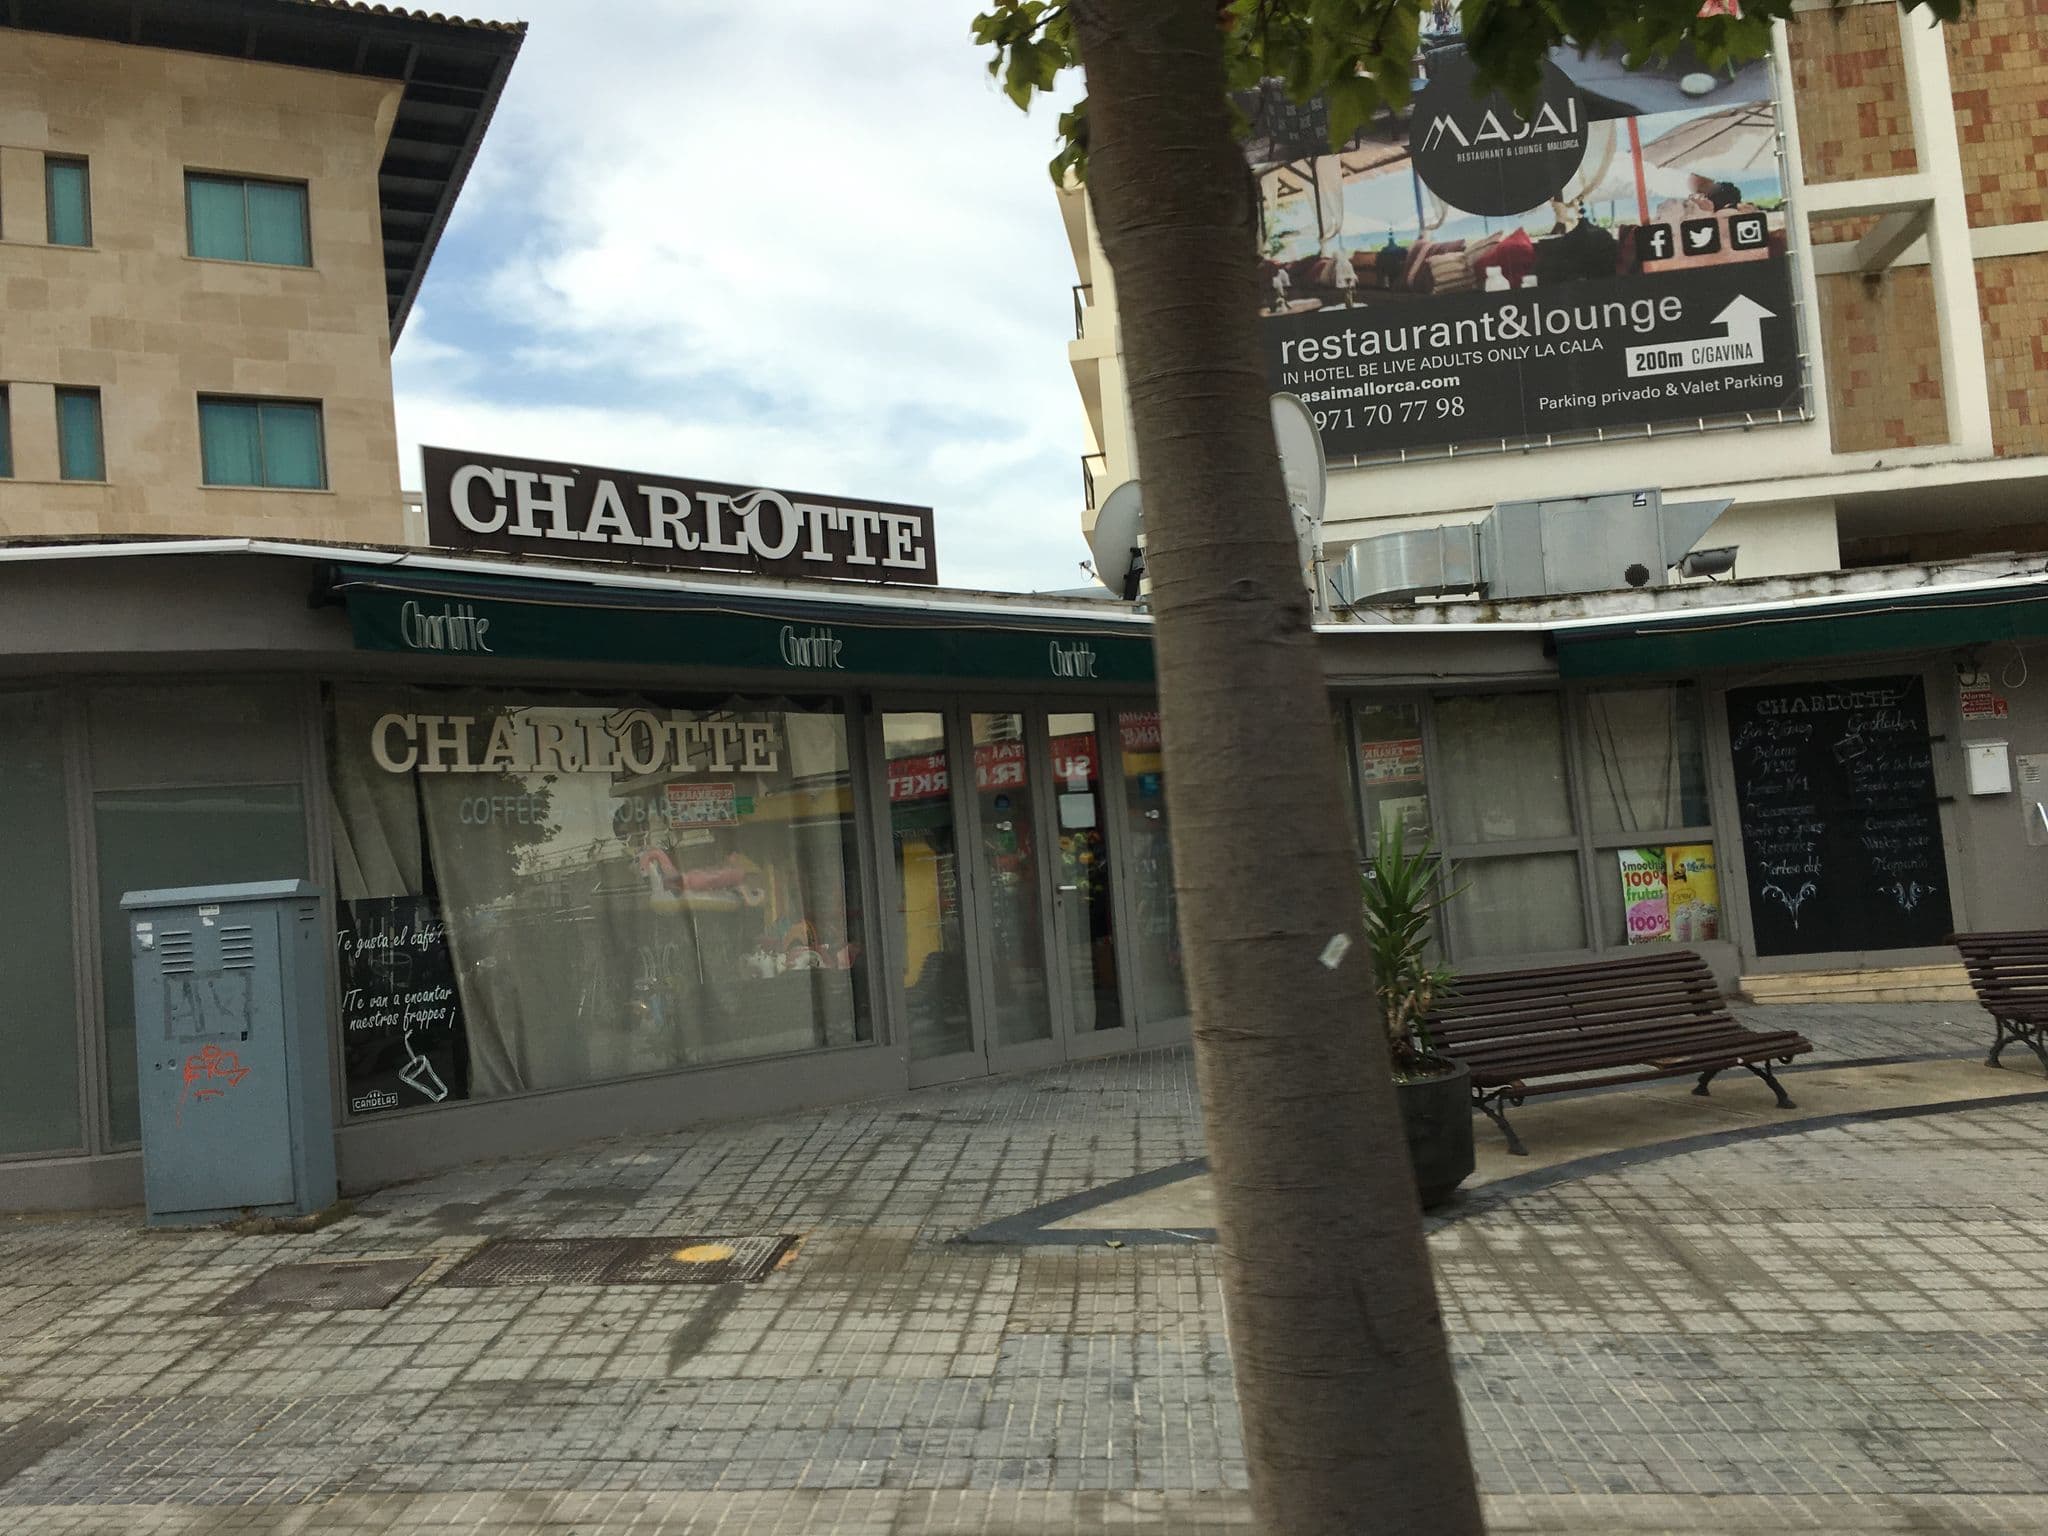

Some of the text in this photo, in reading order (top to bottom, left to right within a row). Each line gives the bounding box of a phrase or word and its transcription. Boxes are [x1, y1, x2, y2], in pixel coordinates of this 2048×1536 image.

[1457, 149, 1504, 162] RESTAURANT
[1514, 144, 1543, 156] LOUNGE
[1547, 139, 1579, 151] MALLORCA
[1282, 338, 1604, 385] IN HOTEL BE LIVE ADULTS ONLY LA CALA
[1636, 342, 1754, 372] 200m C/GAVINA
[1294, 375, 1460, 403] asaimallorca.com
[1539, 374, 1784, 410] Parking privado & Valet Parking
[1314, 396, 1465, 431] 971 70 77 98
[450, 464, 928, 570] CHARLOTTE
[401, 600, 494, 653] Charlotte
[1757, 689, 1896, 715] CHARLOTTE
[371, 708, 779, 775] CHARLOTTE
[1627, 888, 1664, 901] frutas
[337, 923, 445, 959] Te gusta el café?
[370, 995, 389, 1008] van
[394, 995, 400, 1005] a
[404, 985, 452, 1004] encantar
[350, 1012, 399, 1031] nuestros
[354, 1098, 397, 1109] CANDELAS
